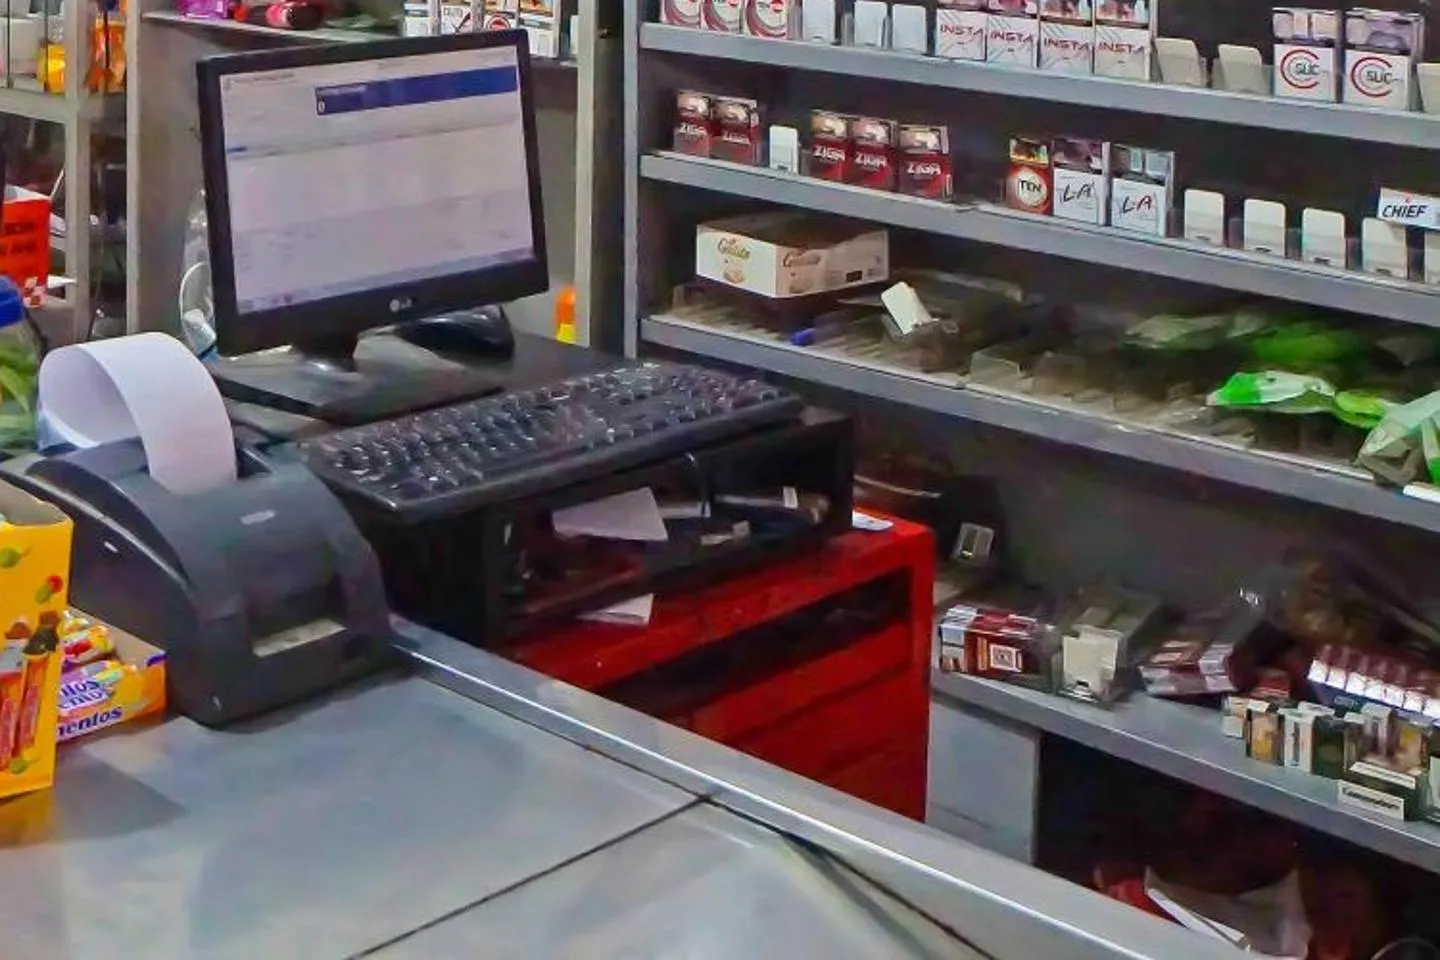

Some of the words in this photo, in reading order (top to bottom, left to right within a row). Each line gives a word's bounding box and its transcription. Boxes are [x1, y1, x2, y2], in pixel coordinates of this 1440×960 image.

[940, 23, 985, 37] INSTA
[990, 31, 1034, 43] INSTA
[1044, 38, 1090, 51] INSTA
[1098, 41, 1145, 54] INSTA
[1382, 204, 1429, 218] CHIEF
